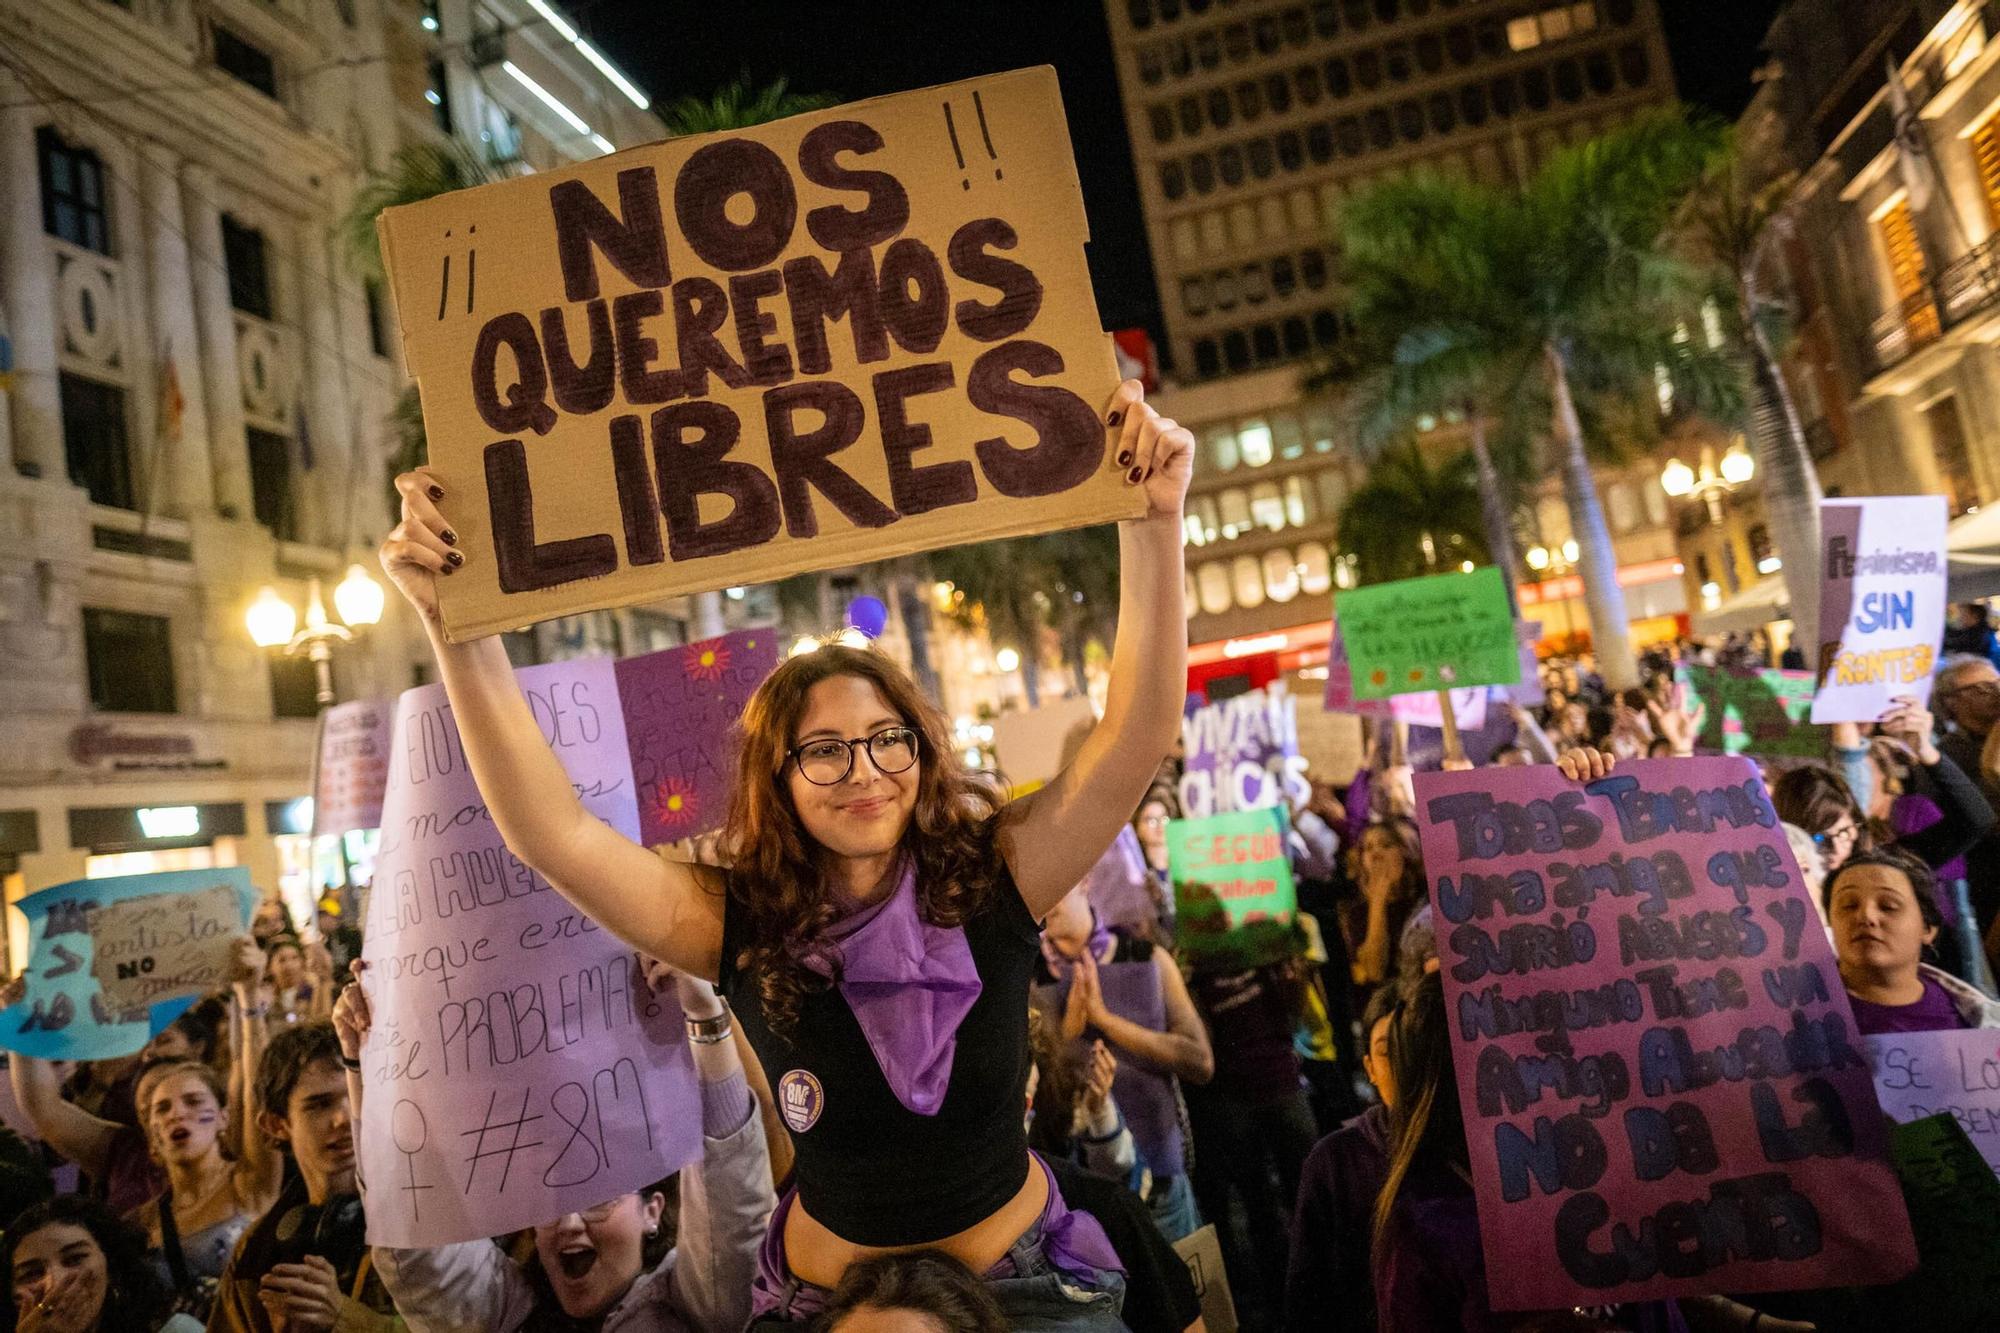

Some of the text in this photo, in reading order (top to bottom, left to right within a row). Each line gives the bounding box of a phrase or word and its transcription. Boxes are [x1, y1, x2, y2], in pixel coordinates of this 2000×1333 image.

[549, 119, 910, 303] NOS
[470, 216, 1045, 437] QUEREMOS
[483, 339, 1108, 595] LIBRES
[1855, 589, 1914, 634] SIN
[1437, 844, 1790, 924] una amiga que
[116, 955, 155, 981] NO
[1761, 961, 1829, 1009] un
[1882, 1047, 1933, 1091] SE
[460, 1057, 653, 1196] #8M
